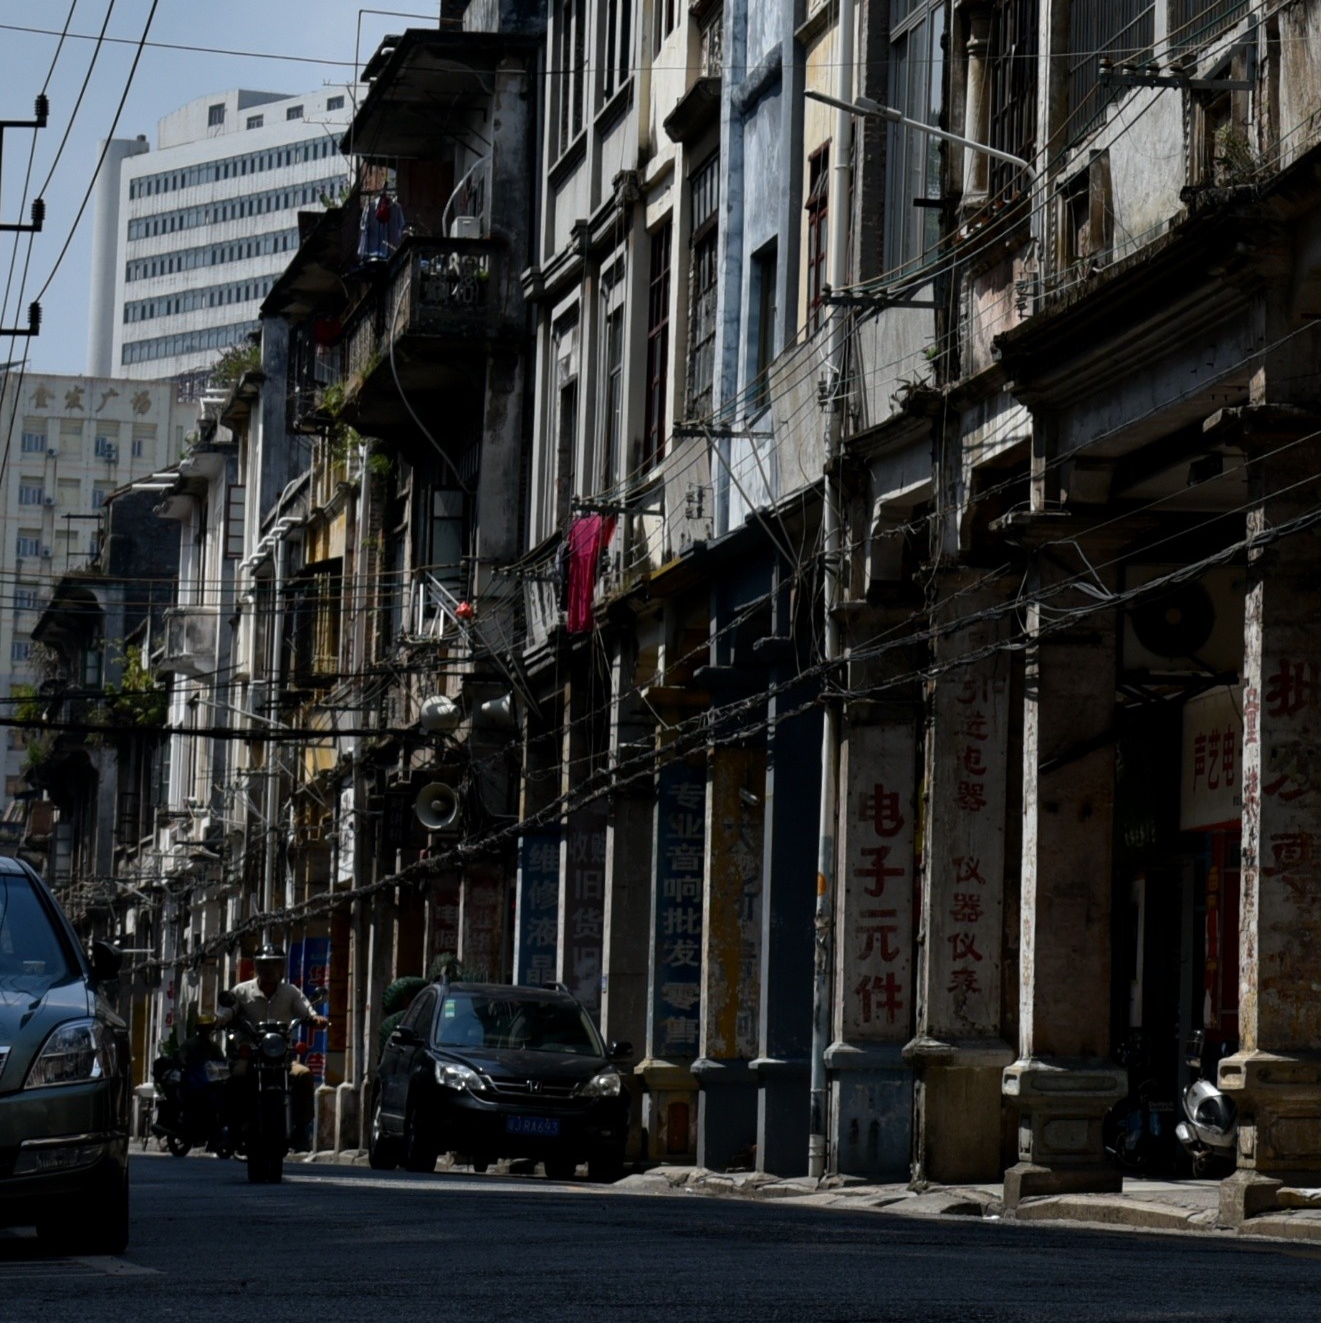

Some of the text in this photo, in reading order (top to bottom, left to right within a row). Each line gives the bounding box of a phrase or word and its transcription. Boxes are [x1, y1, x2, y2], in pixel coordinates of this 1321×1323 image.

[1192, 723, 1242, 794] 声艺电
[852, 782, 905, 1024] 电子元件
